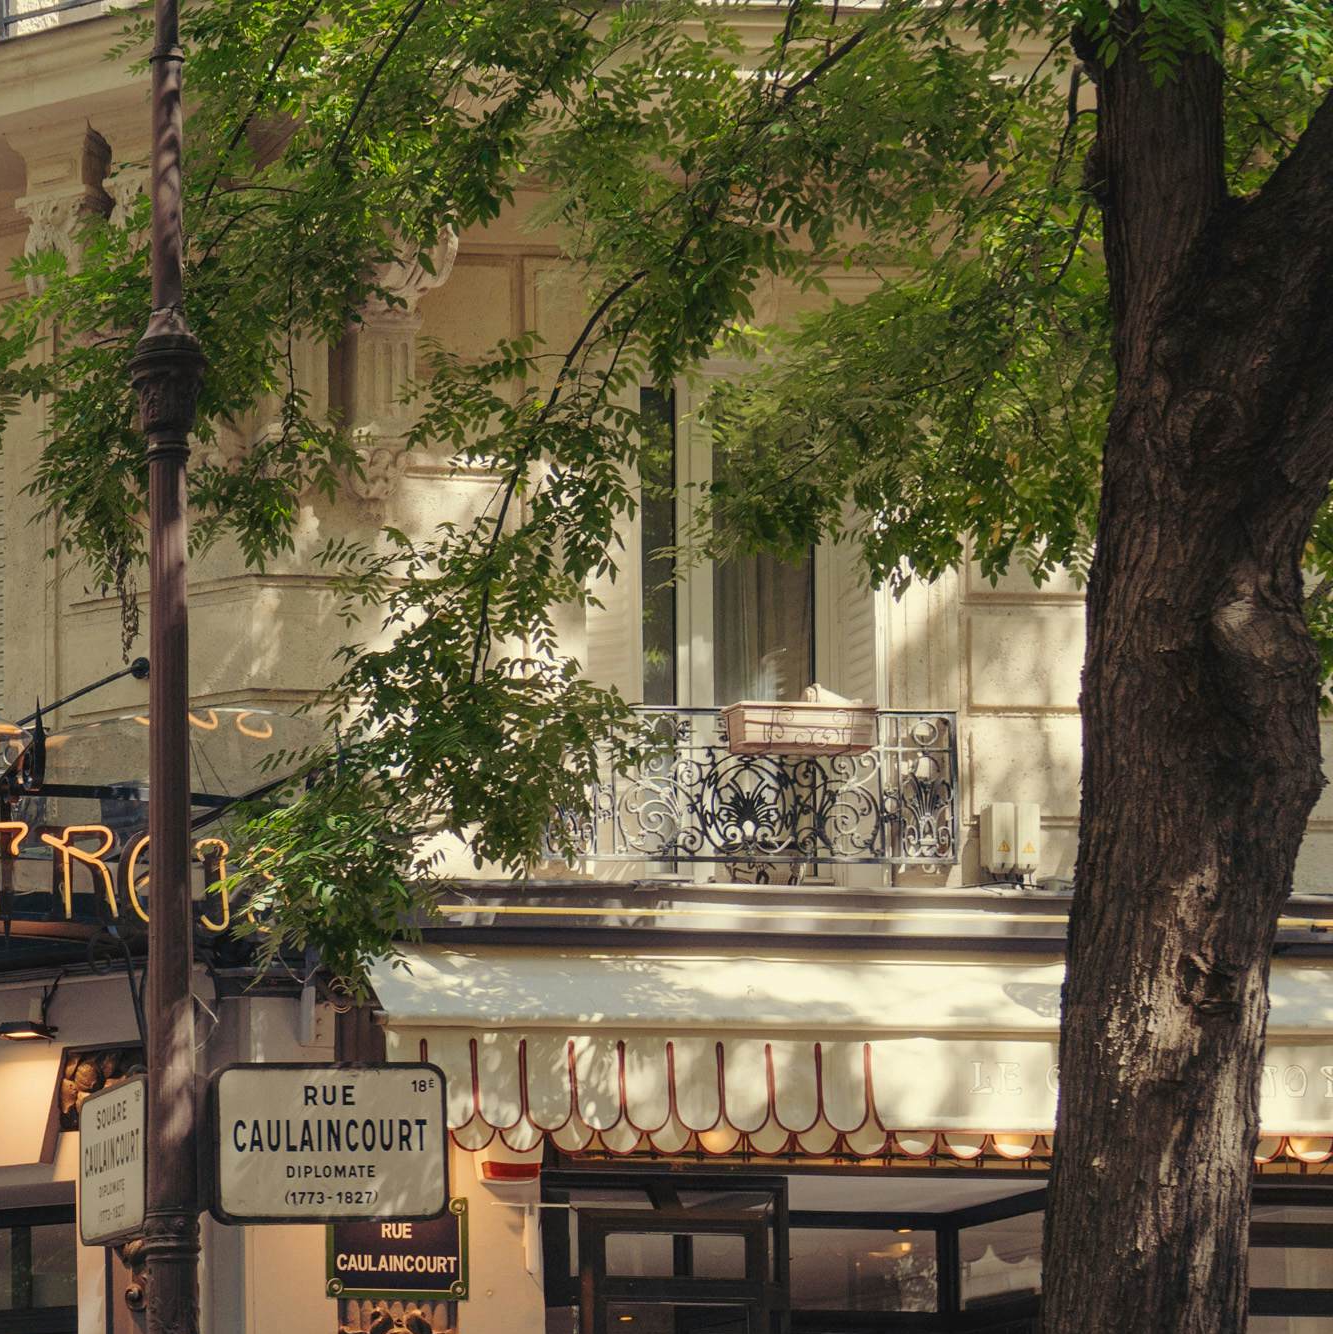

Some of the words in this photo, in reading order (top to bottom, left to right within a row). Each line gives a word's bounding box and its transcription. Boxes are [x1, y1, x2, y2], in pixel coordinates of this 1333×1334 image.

[969, 1061, 1022, 1096] LE
[304, 1085, 356, 1106] RUE
[96, 1100, 128, 1131] SQUARE
[233, 1118, 428, 1153] CAULAINCOURT
[84, 1127, 140, 1178] CAULAINCOURT
[286, 1165, 377, 1179] DIPLOMATE
[284, 1190, 379, 1207] (1773-1827)
[381, 1222, 413, 1239] RUE
[336, 1253, 457, 1274] CAULAINCOURT
